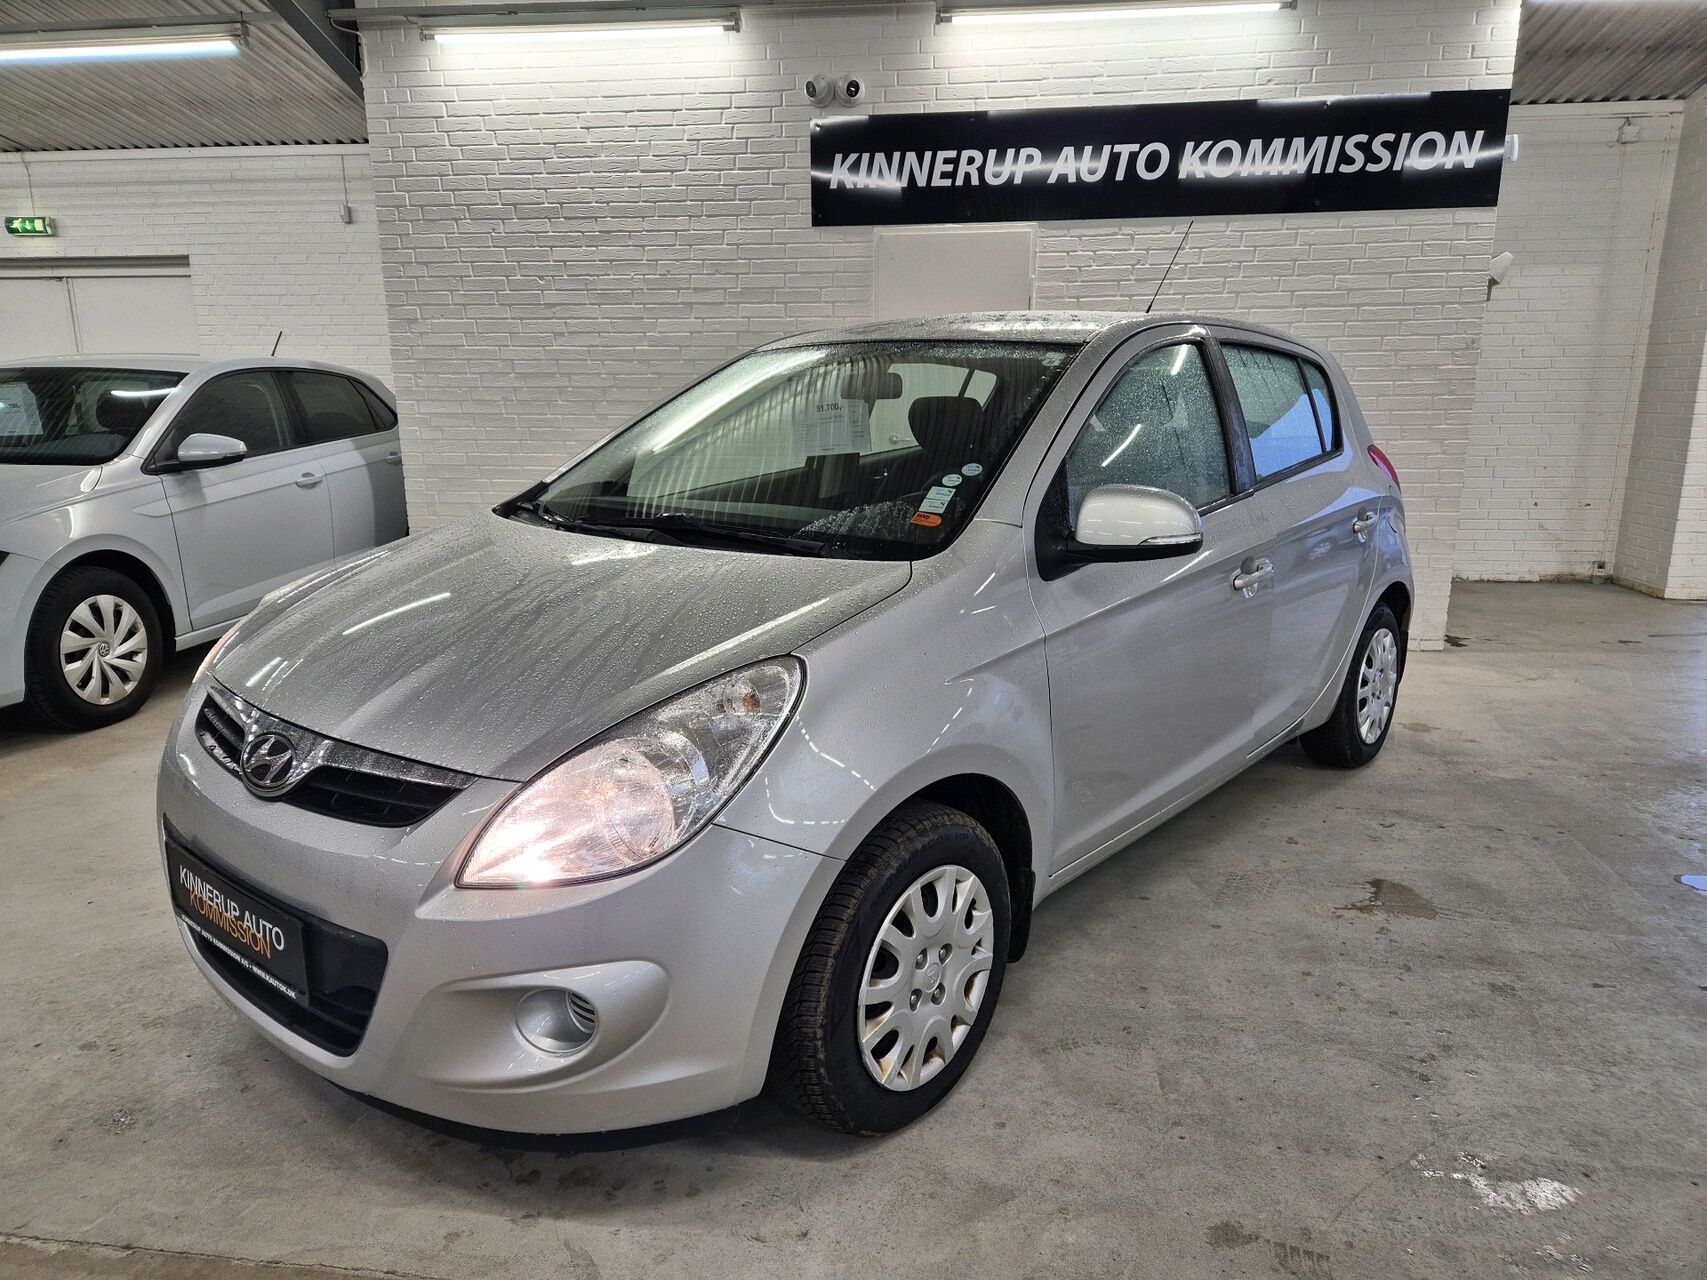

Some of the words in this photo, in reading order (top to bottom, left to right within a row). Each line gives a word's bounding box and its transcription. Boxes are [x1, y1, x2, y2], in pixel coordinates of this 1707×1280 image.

[829, 147, 1042, 189] KINNERUP
[1047, 142, 1170, 184] AUTO
[1178, 130, 1485, 179] KOMMISSION
[180, 865, 240, 918] KINNERUP
[243, 911, 285, 951] AUTO
[190, 887, 272, 959] KOMMISSION
